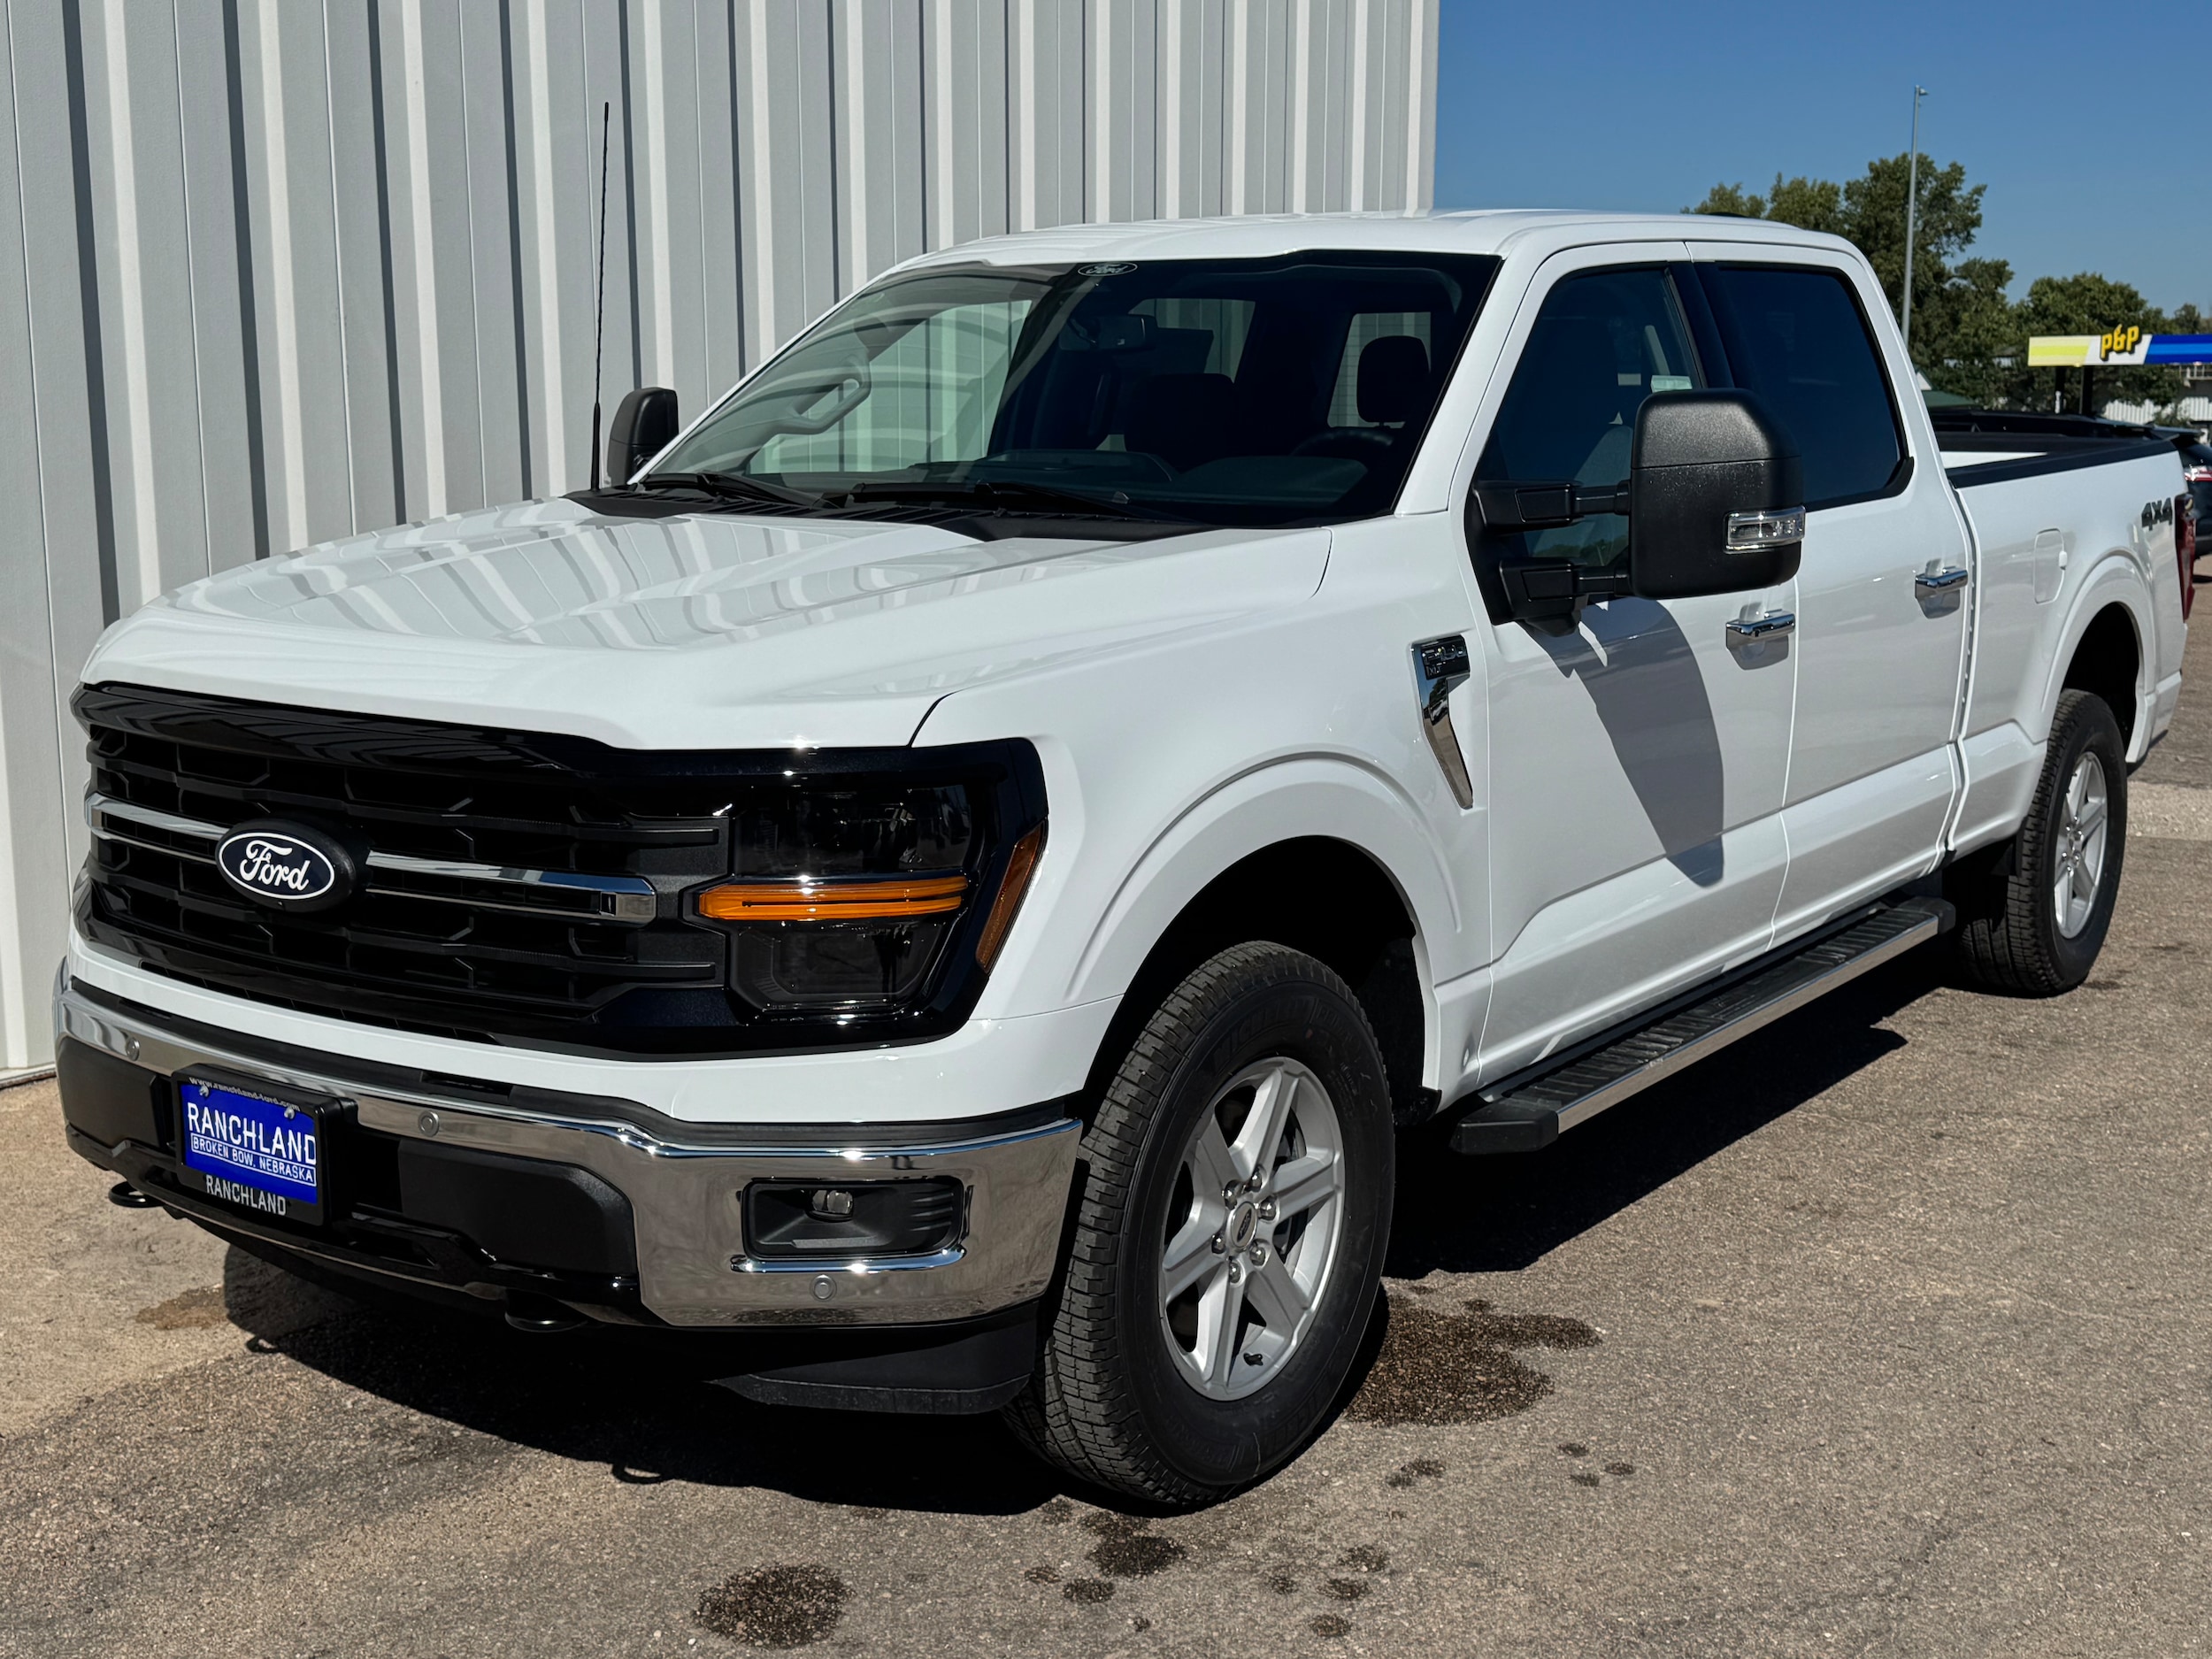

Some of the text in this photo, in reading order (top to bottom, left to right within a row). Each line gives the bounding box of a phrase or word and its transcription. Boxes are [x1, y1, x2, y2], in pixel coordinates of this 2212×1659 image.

[2101, 324, 2140, 359] P&P
[240, 840, 311, 891] Ford
[188, 1102, 316, 1165] RANCHLAND
[194, 1138, 229, 1158] BROKEN
[259, 1156, 314, 1183] NEBRASKA
[206, 1175, 287, 1216] RANCHLAND
